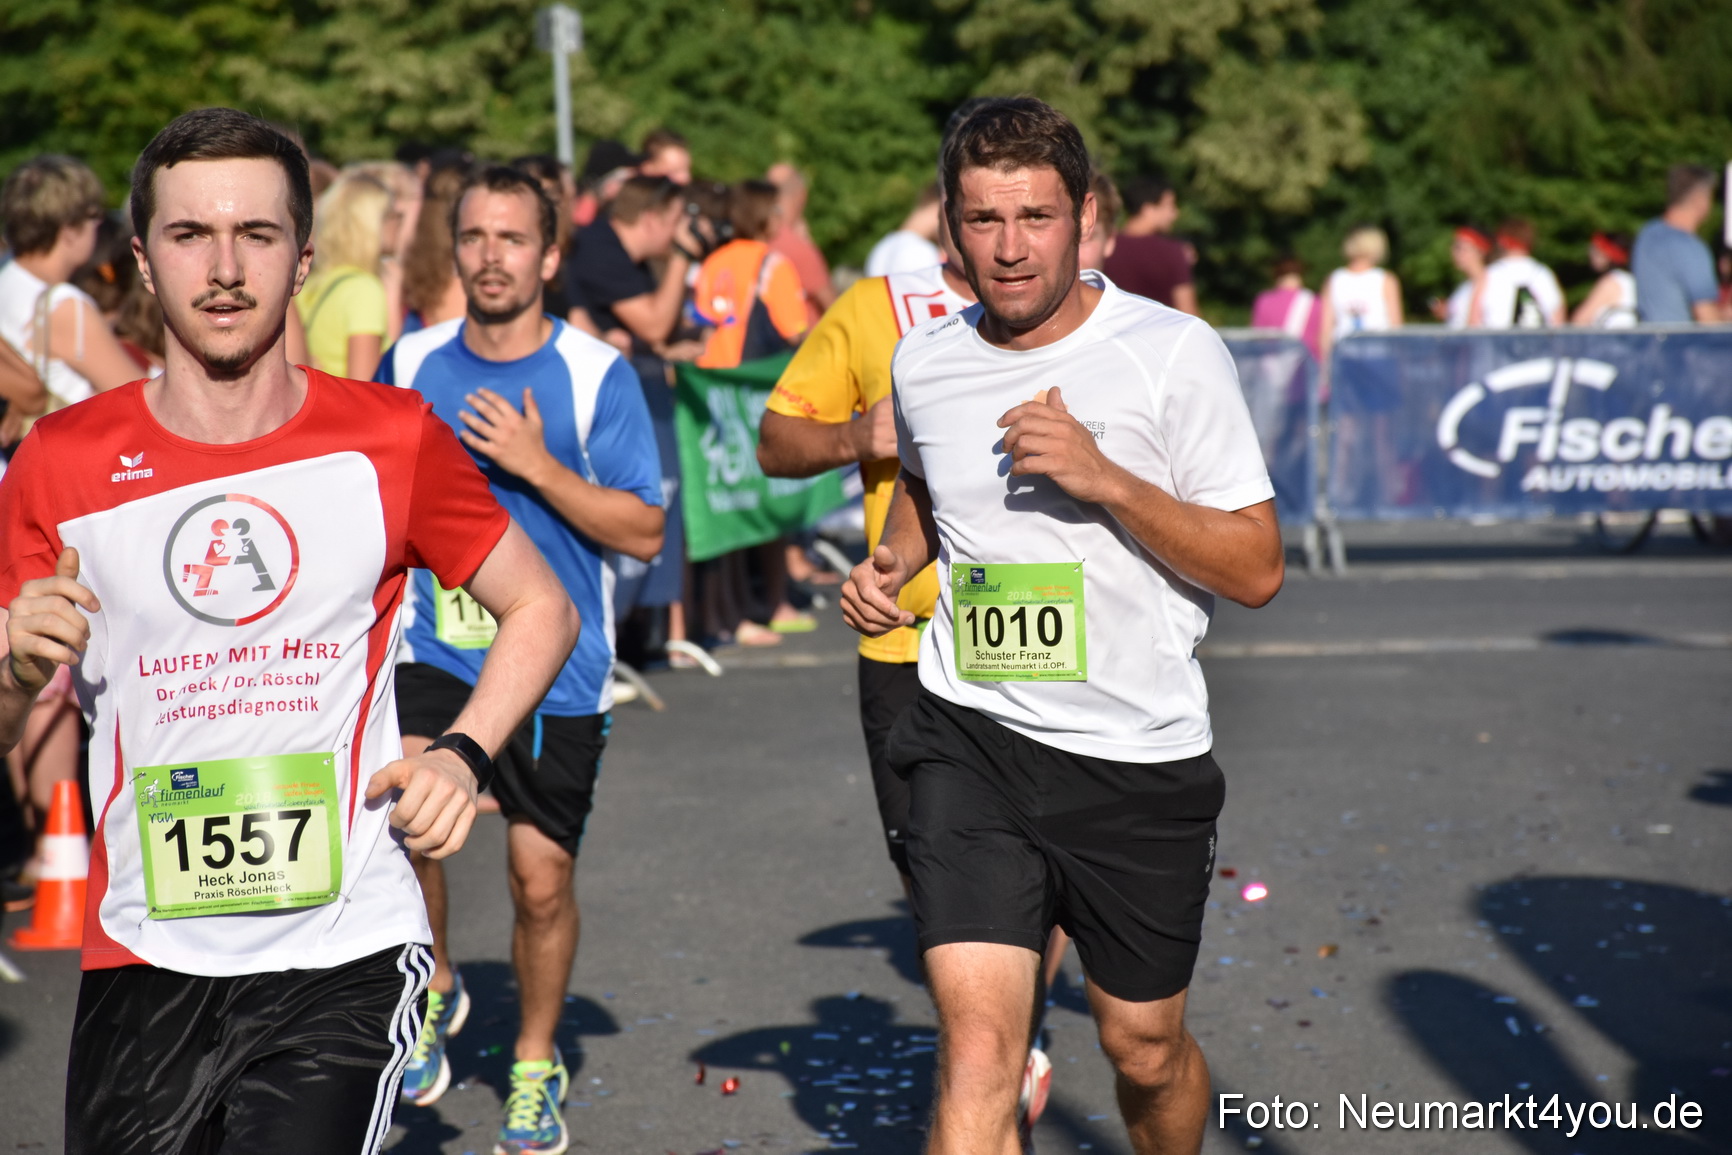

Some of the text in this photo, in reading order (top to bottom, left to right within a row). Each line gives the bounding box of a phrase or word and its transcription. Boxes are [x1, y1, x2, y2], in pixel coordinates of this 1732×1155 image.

[111, 468, 153, 483] erima
[1520, 461, 1732, 493] AUTOMOBIL
[1006, 591, 1033, 601] 2018
[966, 605, 1063, 648] 1010
[138, 638, 341, 677] LAUFEN MIT HERZ
[975, 649, 1052, 661] Schuster Franz
[966, 663, 1000, 671] Landratsamt
[234, 676, 257, 688] Dr.
[262, 672, 320, 686] Röschl
[160, 783, 226, 802] firmenlauf
[164, 808, 312, 872] 1557
[198, 870, 286, 888] Heck Jonas
[194, 883, 292, 900] Praxis Röschl-Heck
